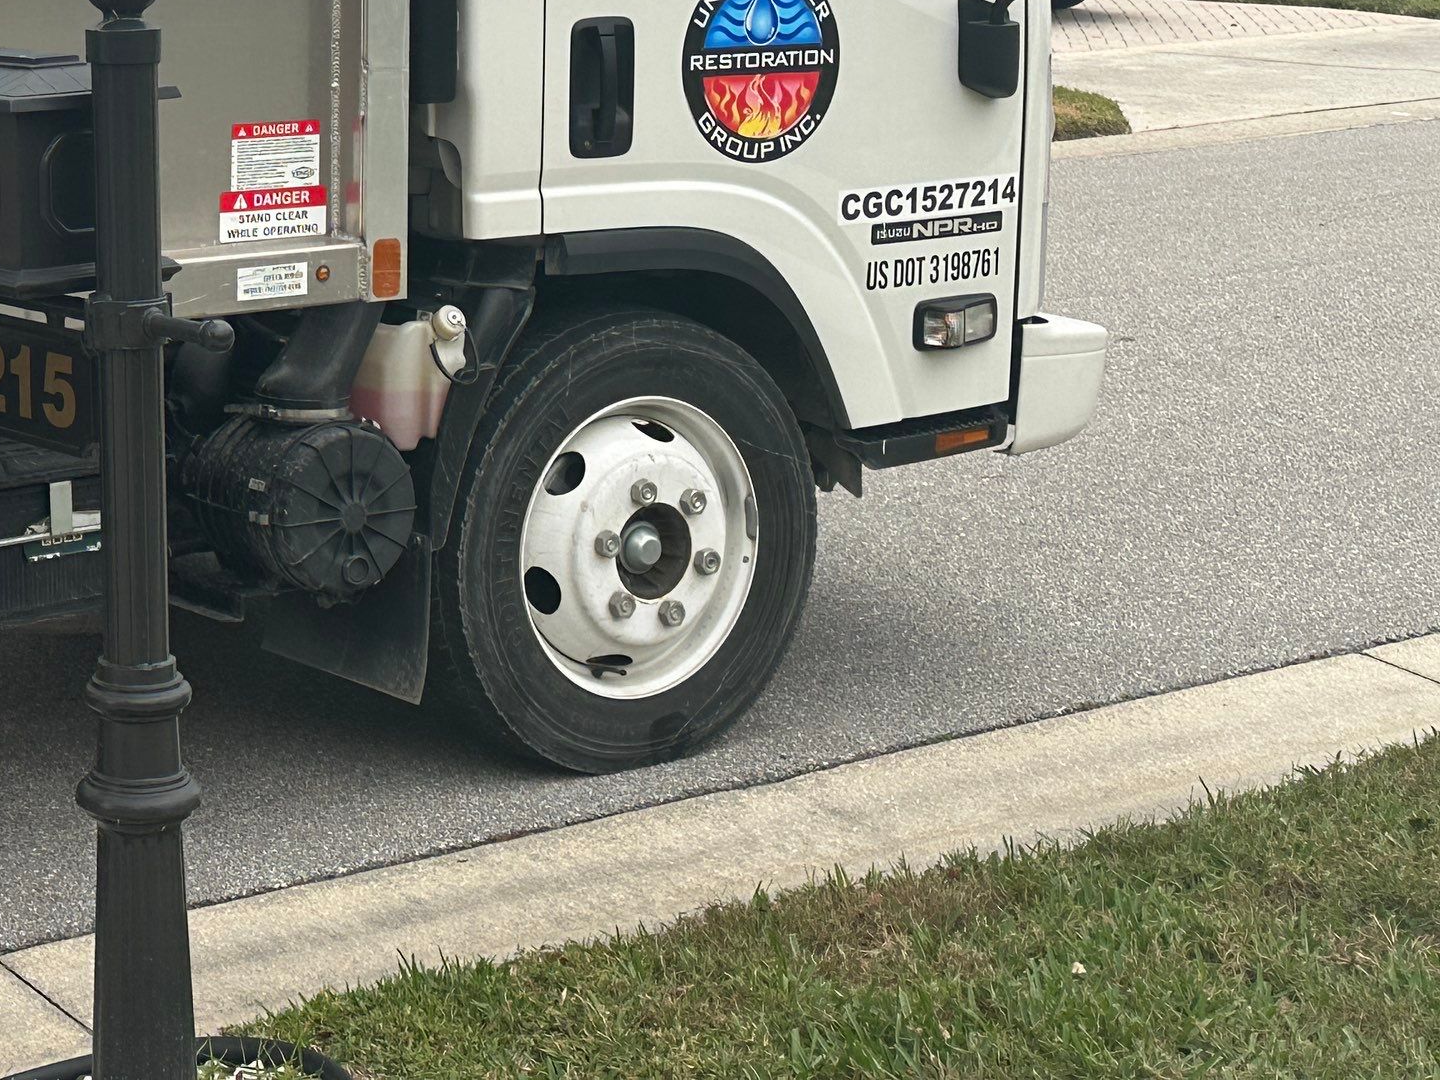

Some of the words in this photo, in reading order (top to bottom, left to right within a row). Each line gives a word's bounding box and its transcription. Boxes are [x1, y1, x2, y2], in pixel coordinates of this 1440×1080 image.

[690, 49, 834, 71] RESTORATION
[252, 122, 299, 136] DANGER
[698, 112, 775, 159] GROUP
[253, 190, 310, 207] DANGER
[841, 176, 1016, 221] CGC1527214
[238, 212, 271, 224] STAND
[275, 210, 308, 221] CLEAR
[227, 227, 258, 239] WHILE
[263, 223, 319, 236] OPERATING
[876, 228, 911, 240] ISUZU
[912, 217, 973, 238] NPR
[866, 260, 889, 291] US
[894, 256, 926, 288] DOT
[929, 247, 1000, 284] 3198761
